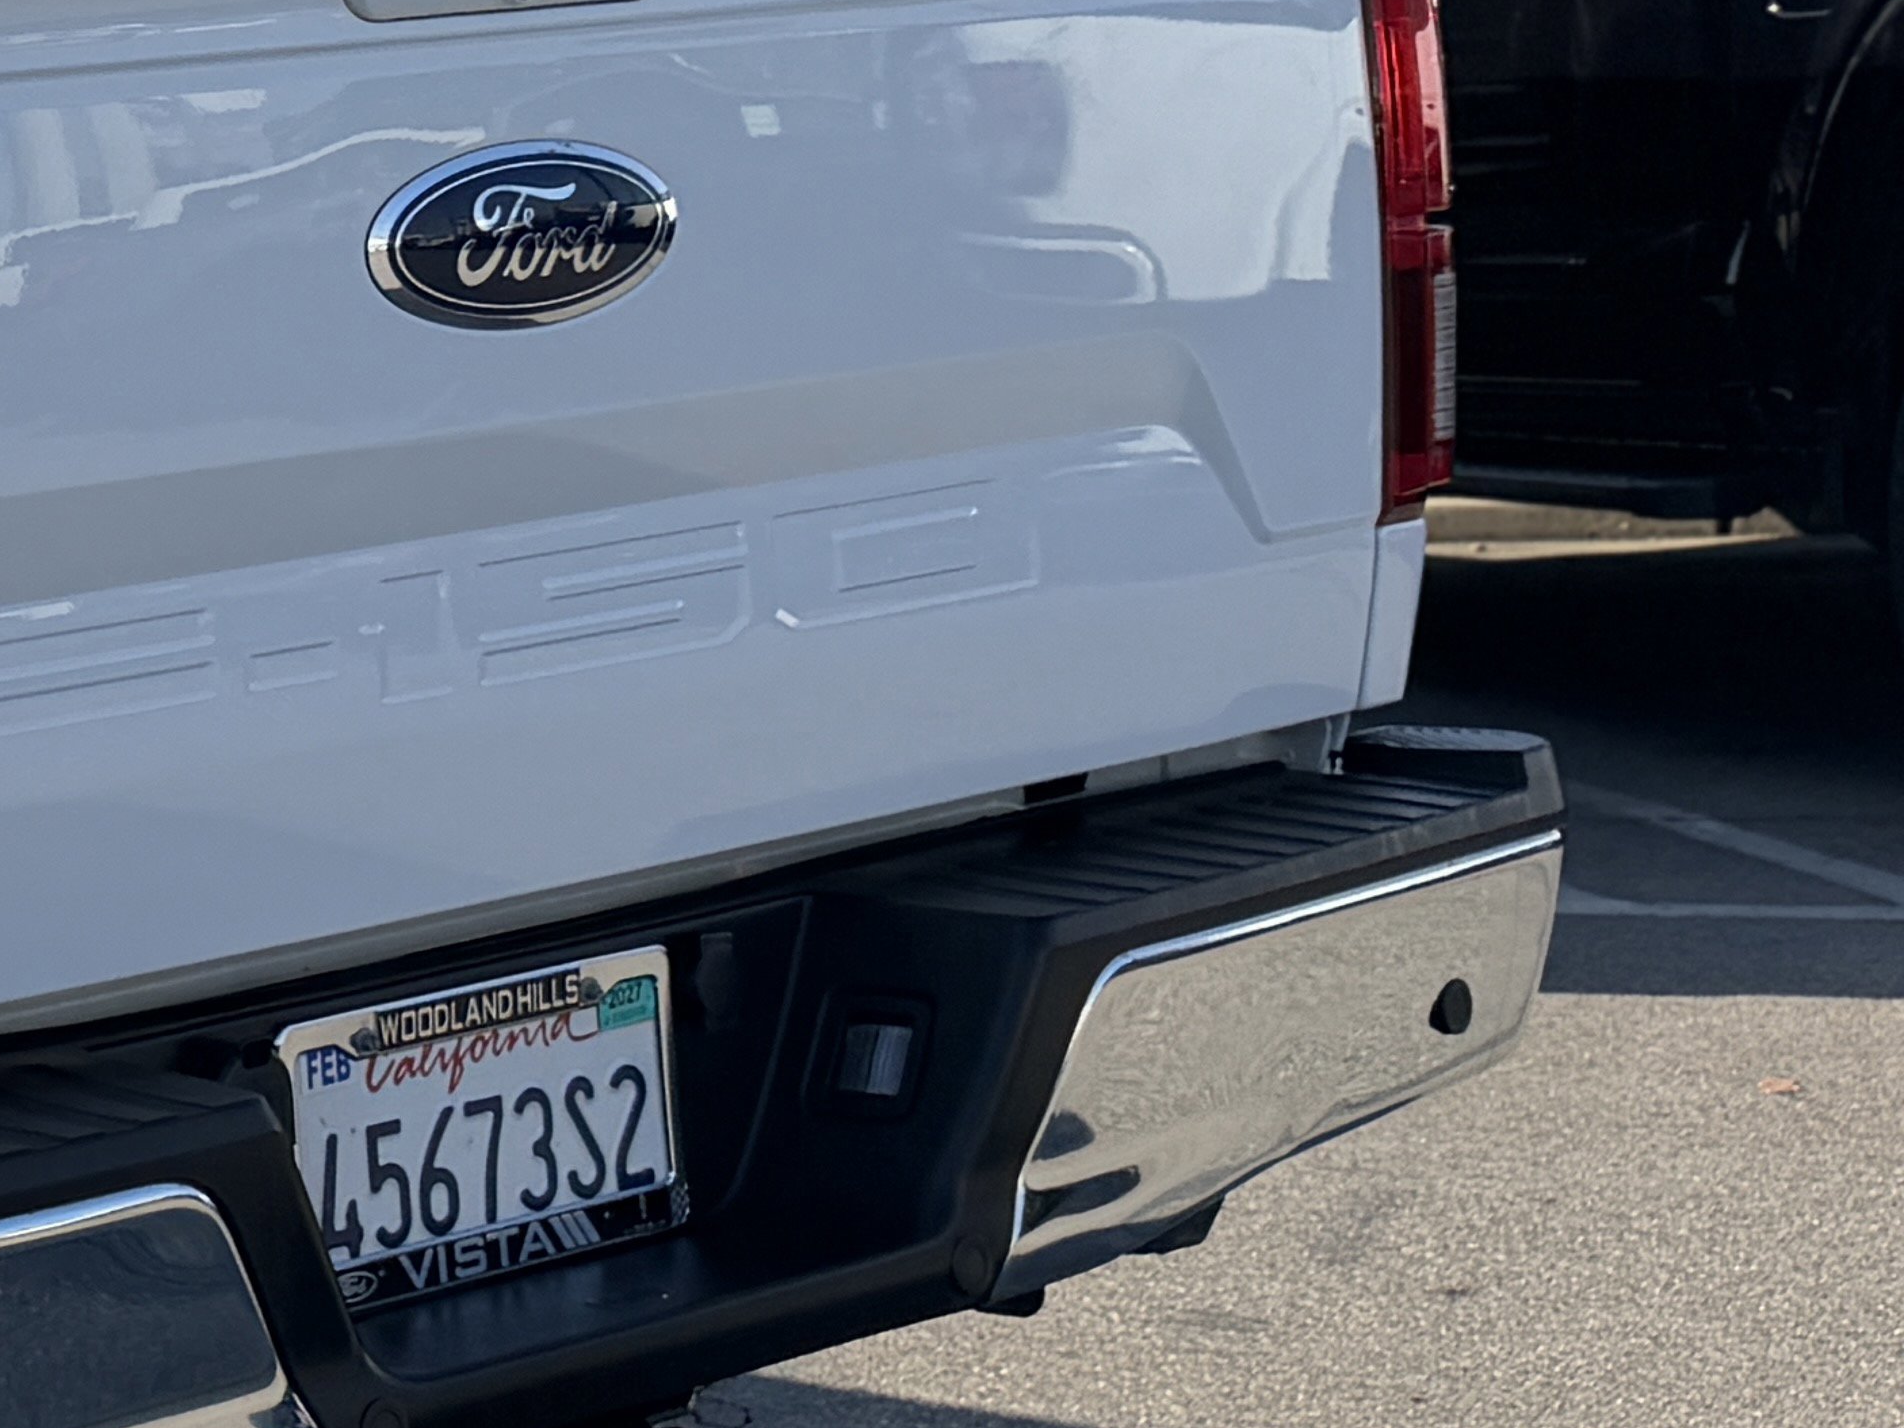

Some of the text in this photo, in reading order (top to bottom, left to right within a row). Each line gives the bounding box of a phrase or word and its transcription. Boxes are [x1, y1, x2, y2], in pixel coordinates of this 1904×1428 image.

[455, 182, 617, 288] Ford
[377, 975, 580, 1046] WOODLAND HILLS
[607, 981, 643, 1010] 2027
[306, 1049, 351, 1090] FEB
[364, 1012, 600, 1094] California
[322, 1064, 656, 1260] 45673S2
[399, 1216, 558, 1290] VISTA
